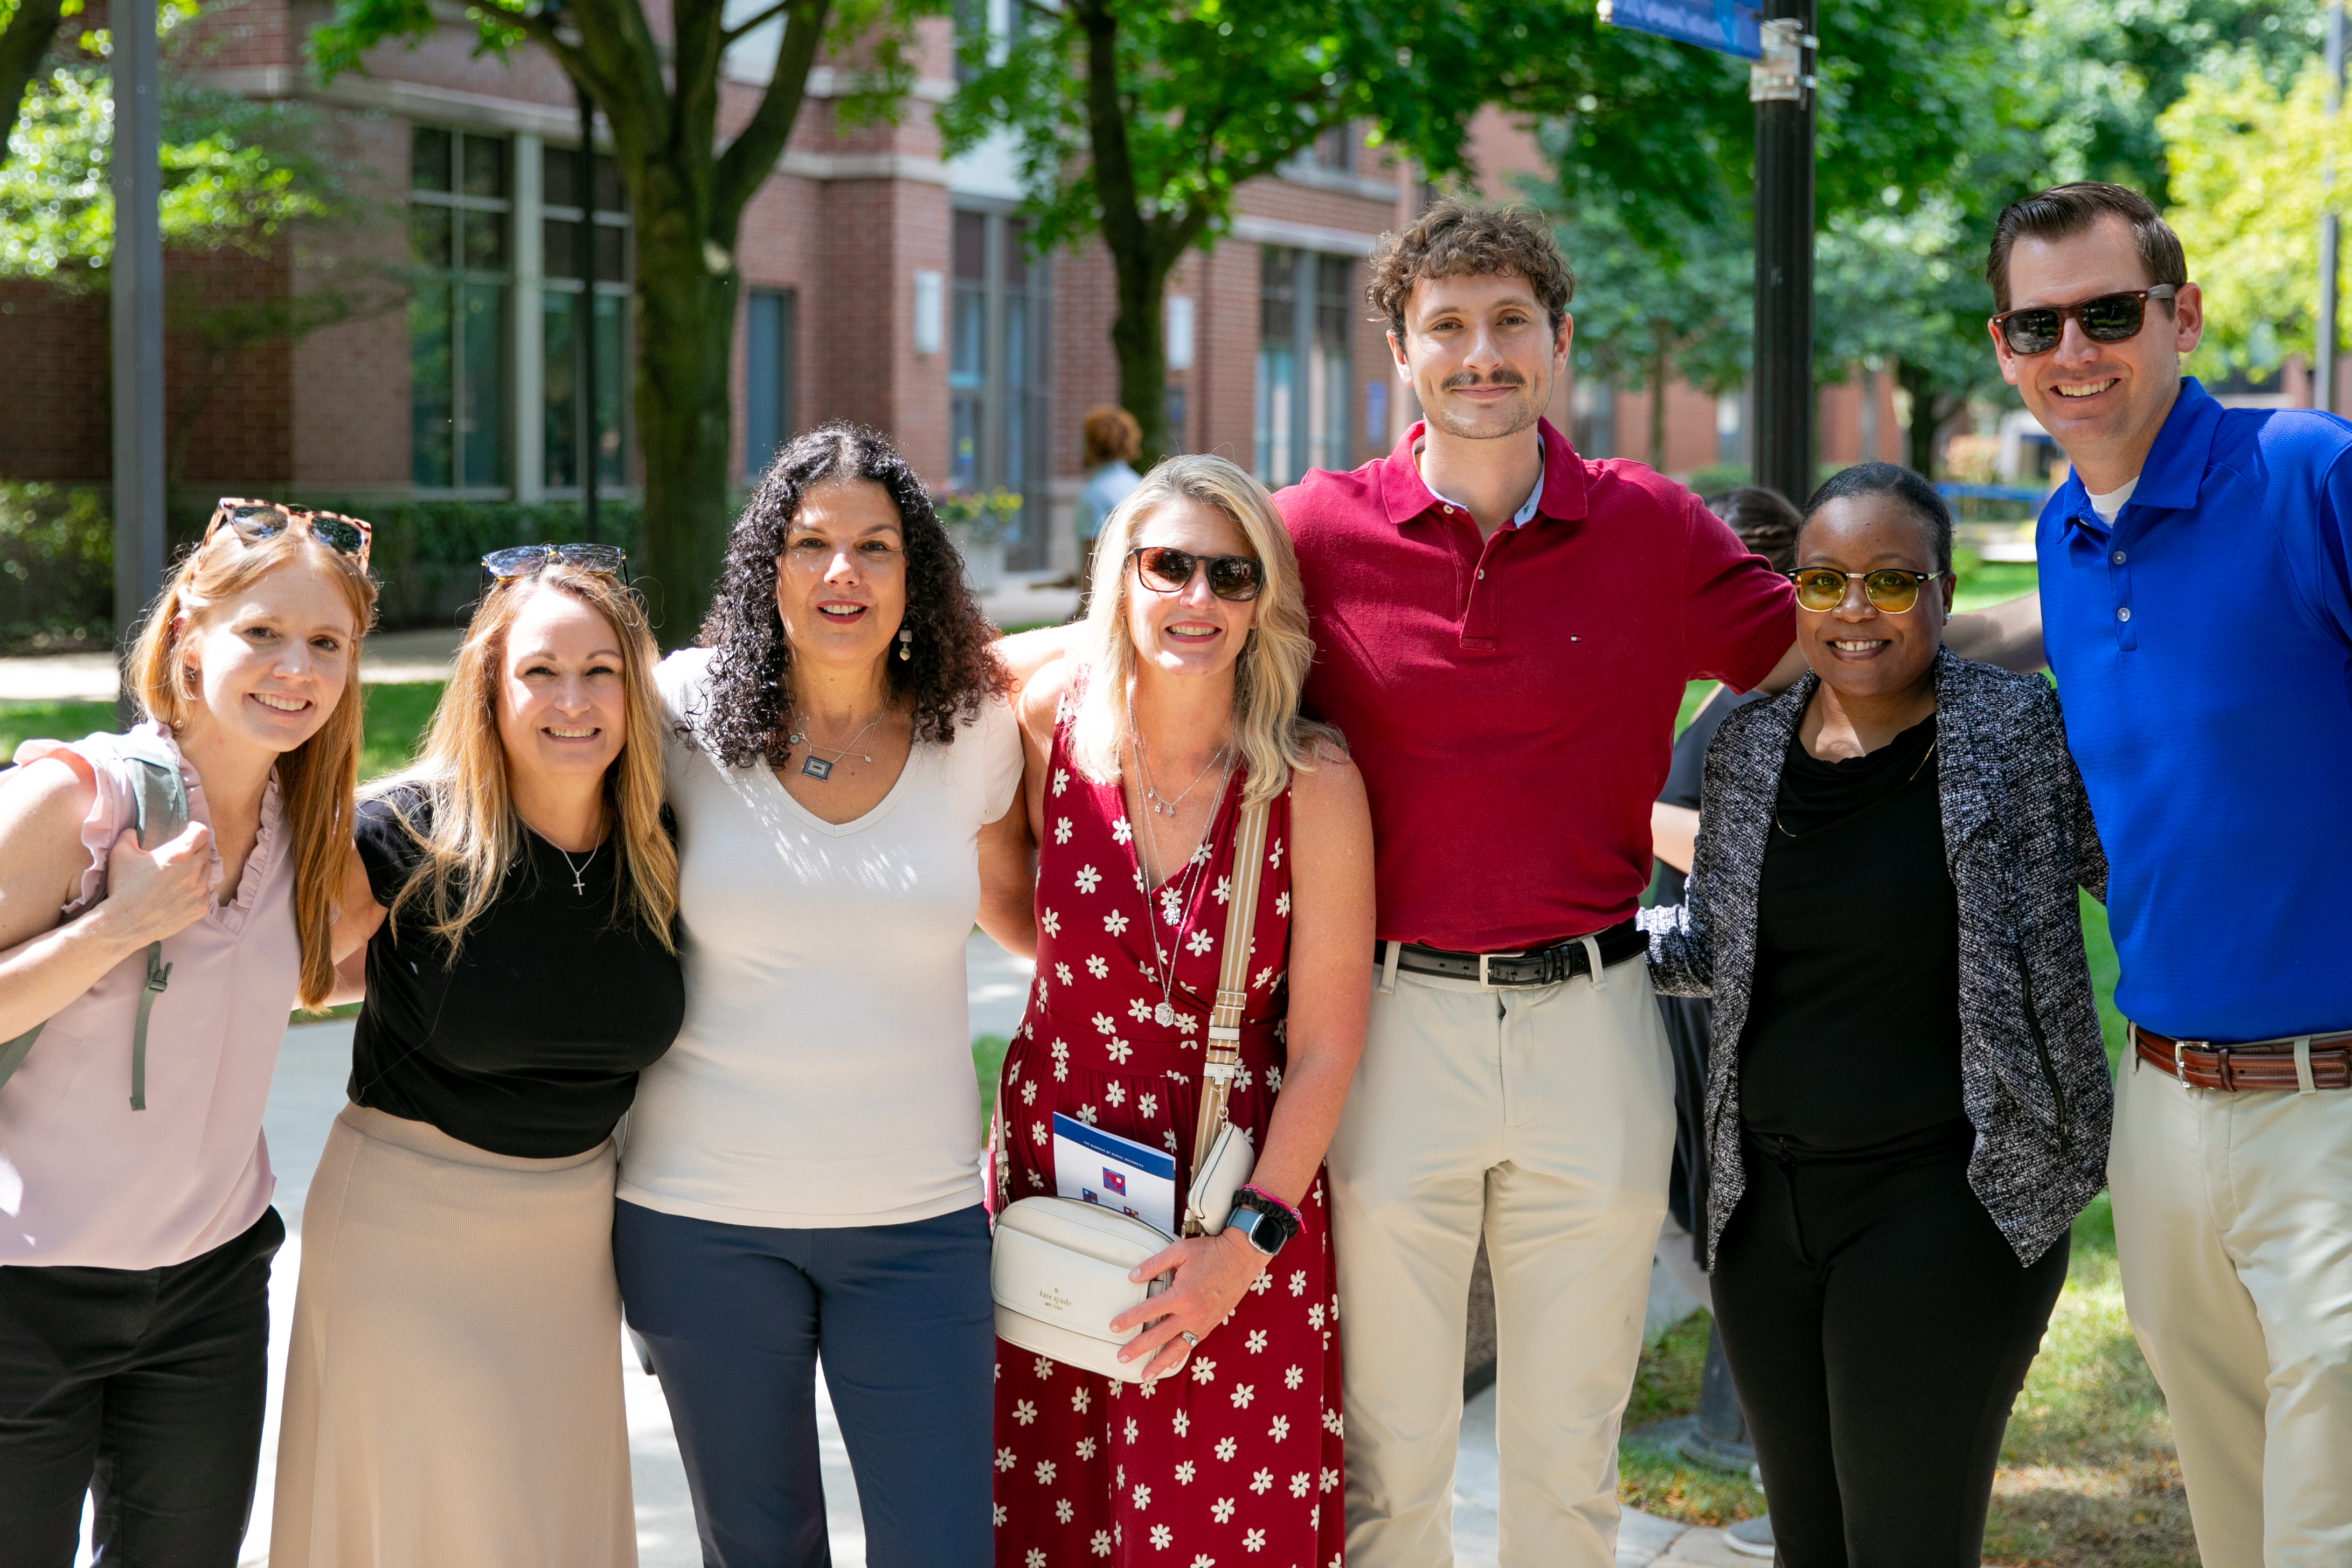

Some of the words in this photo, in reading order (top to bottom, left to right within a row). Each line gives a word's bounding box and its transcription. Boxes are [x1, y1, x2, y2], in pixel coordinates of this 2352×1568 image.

[1090, 1144, 1106, 1153] BANNERS
[1124, 1157, 1144, 1168] UNIVERSITY
[1039, 1289, 1052, 1300] kate
[1053, 1296, 1072, 1307] spade
